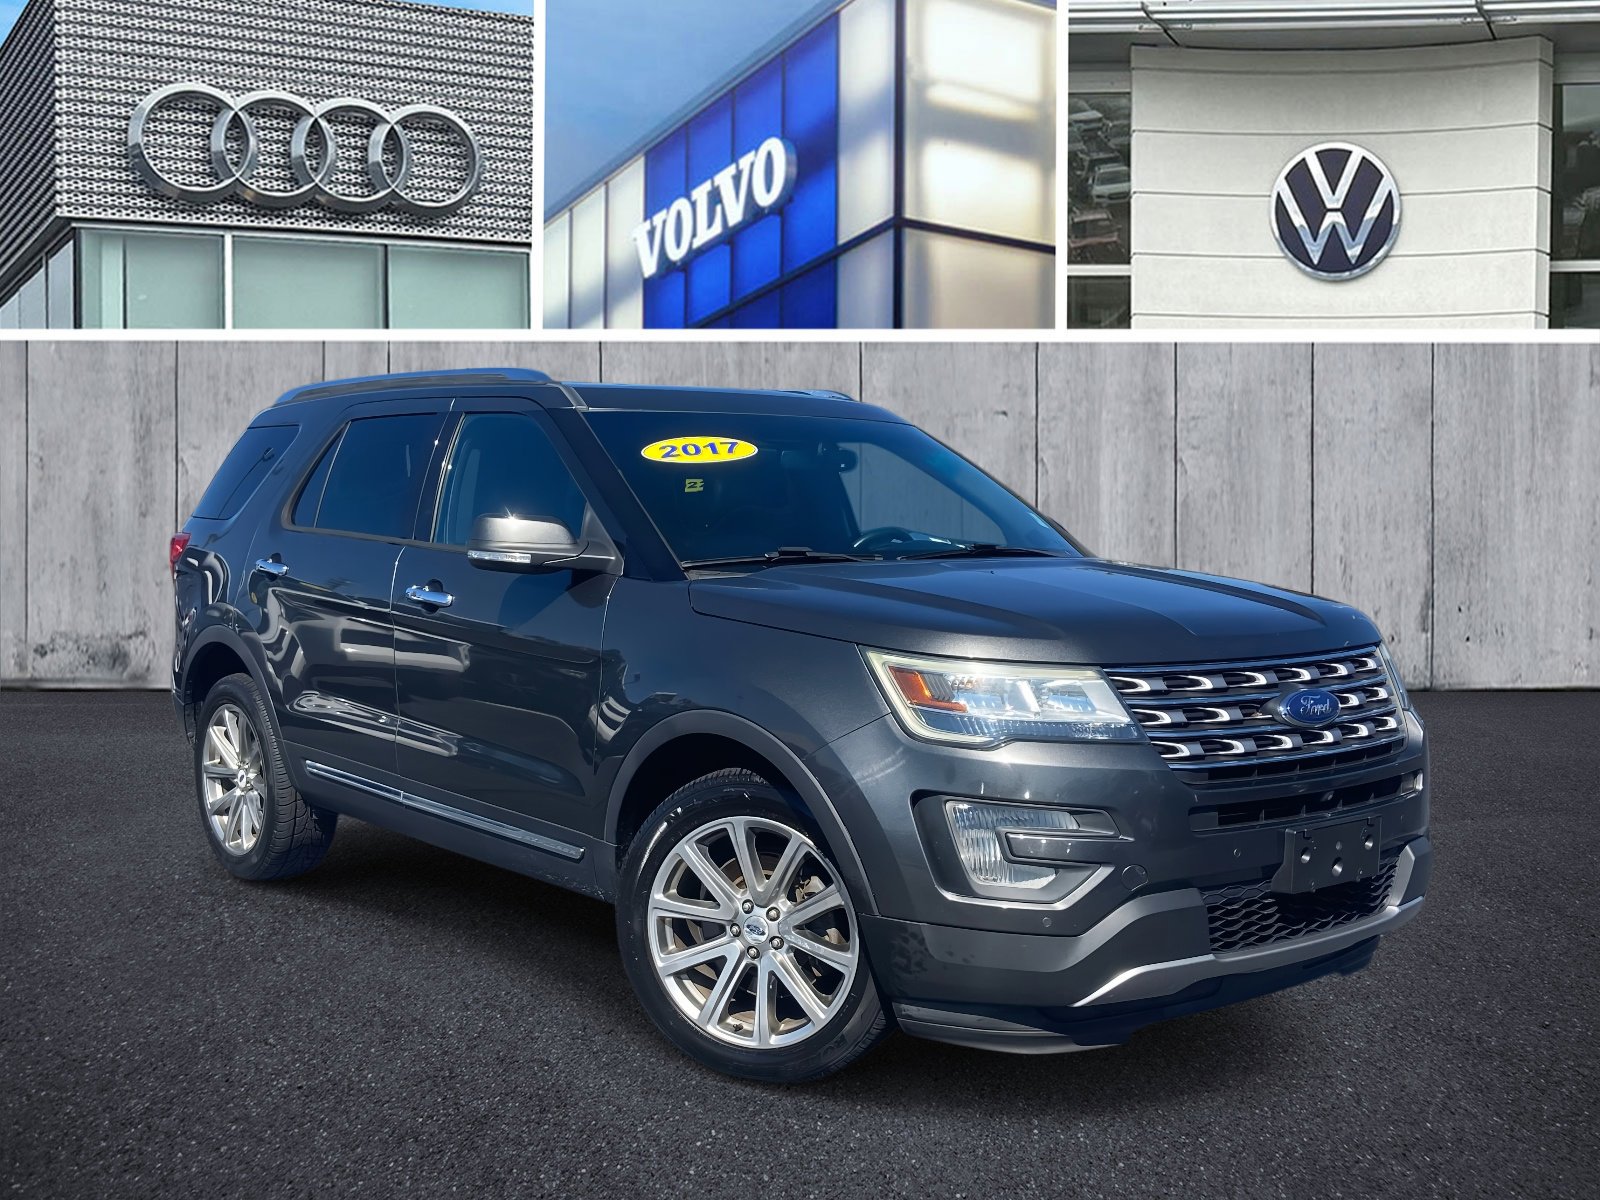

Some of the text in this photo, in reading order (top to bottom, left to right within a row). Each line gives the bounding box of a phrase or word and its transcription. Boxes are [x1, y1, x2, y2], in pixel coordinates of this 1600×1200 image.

[632, 136, 789, 279] VOLVO
[1274, 146, 1398, 268] VW
[659, 441, 739, 459] 2017
[1300, 695, 1332, 715] Ford
